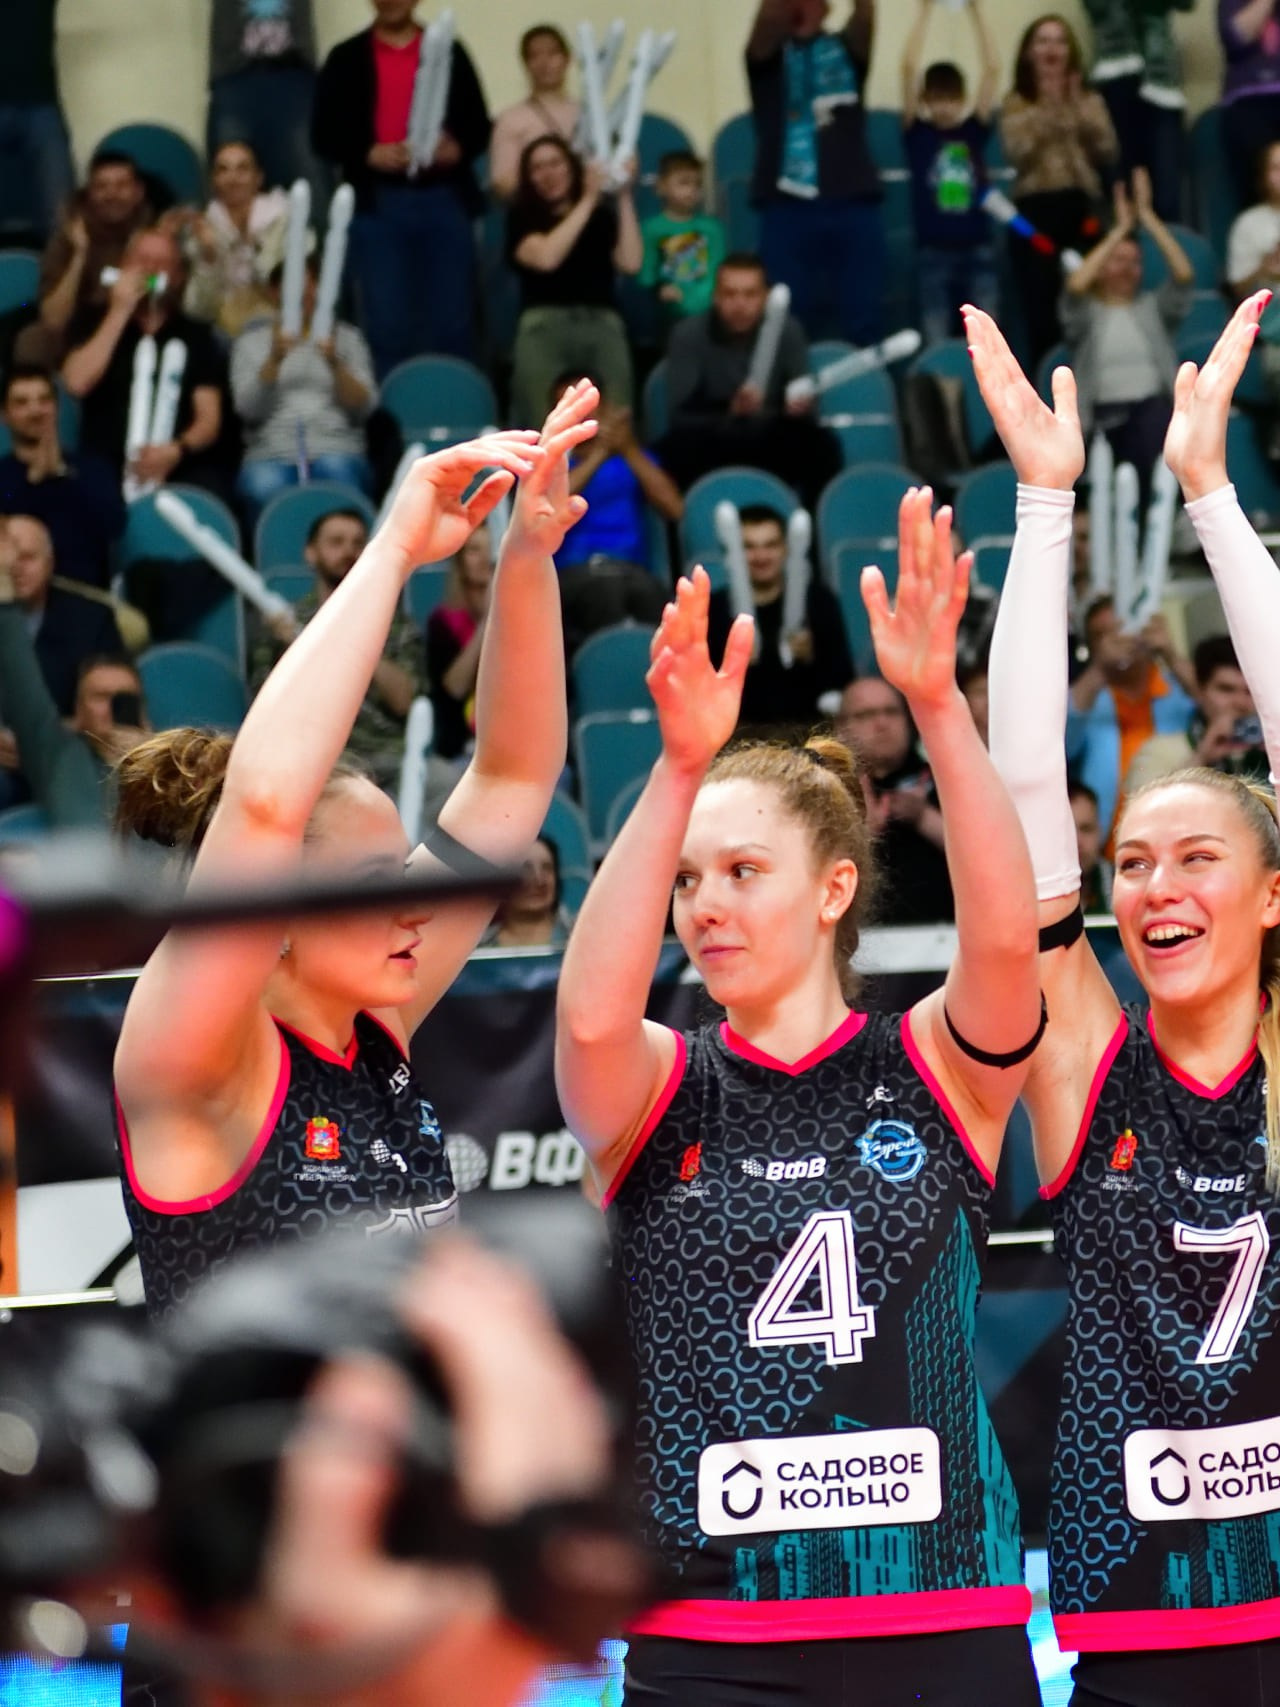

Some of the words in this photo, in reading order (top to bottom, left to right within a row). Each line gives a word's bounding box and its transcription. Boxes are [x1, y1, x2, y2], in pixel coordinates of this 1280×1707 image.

[489, 1129, 585, 1191] ВФ
[765, 1157, 826, 1181] ВФВ
[748, 1210, 876, 1365] 4
[1173, 1211, 1270, 1364] 7
[777, 1453, 924, 1484] САДОВОЕ
[780, 1482, 910, 1510] КОЛЬЦО
